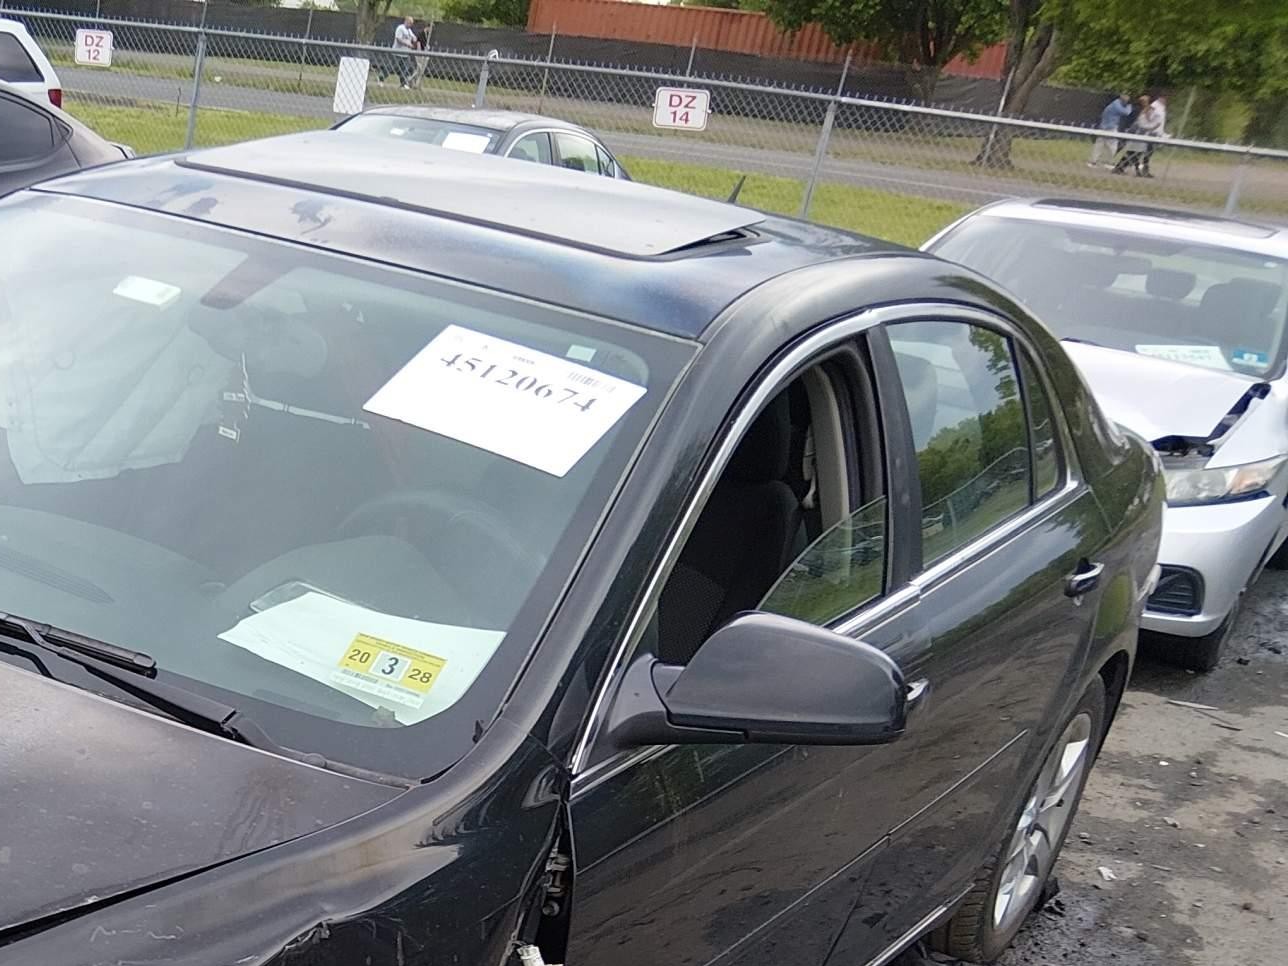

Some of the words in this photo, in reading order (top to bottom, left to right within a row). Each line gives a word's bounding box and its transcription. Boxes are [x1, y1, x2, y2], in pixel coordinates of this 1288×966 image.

[84, 34, 104, 47] DZ
[87, 49, 100, 61] 12
[668, 93, 697, 110] DZ
[670, 110, 691, 125] 14
[440, 353, 597, 412] 45120674
[348, 648, 371, 664] 20
[381, 656, 400, 676] 3
[407, 667, 433, 684] 28
